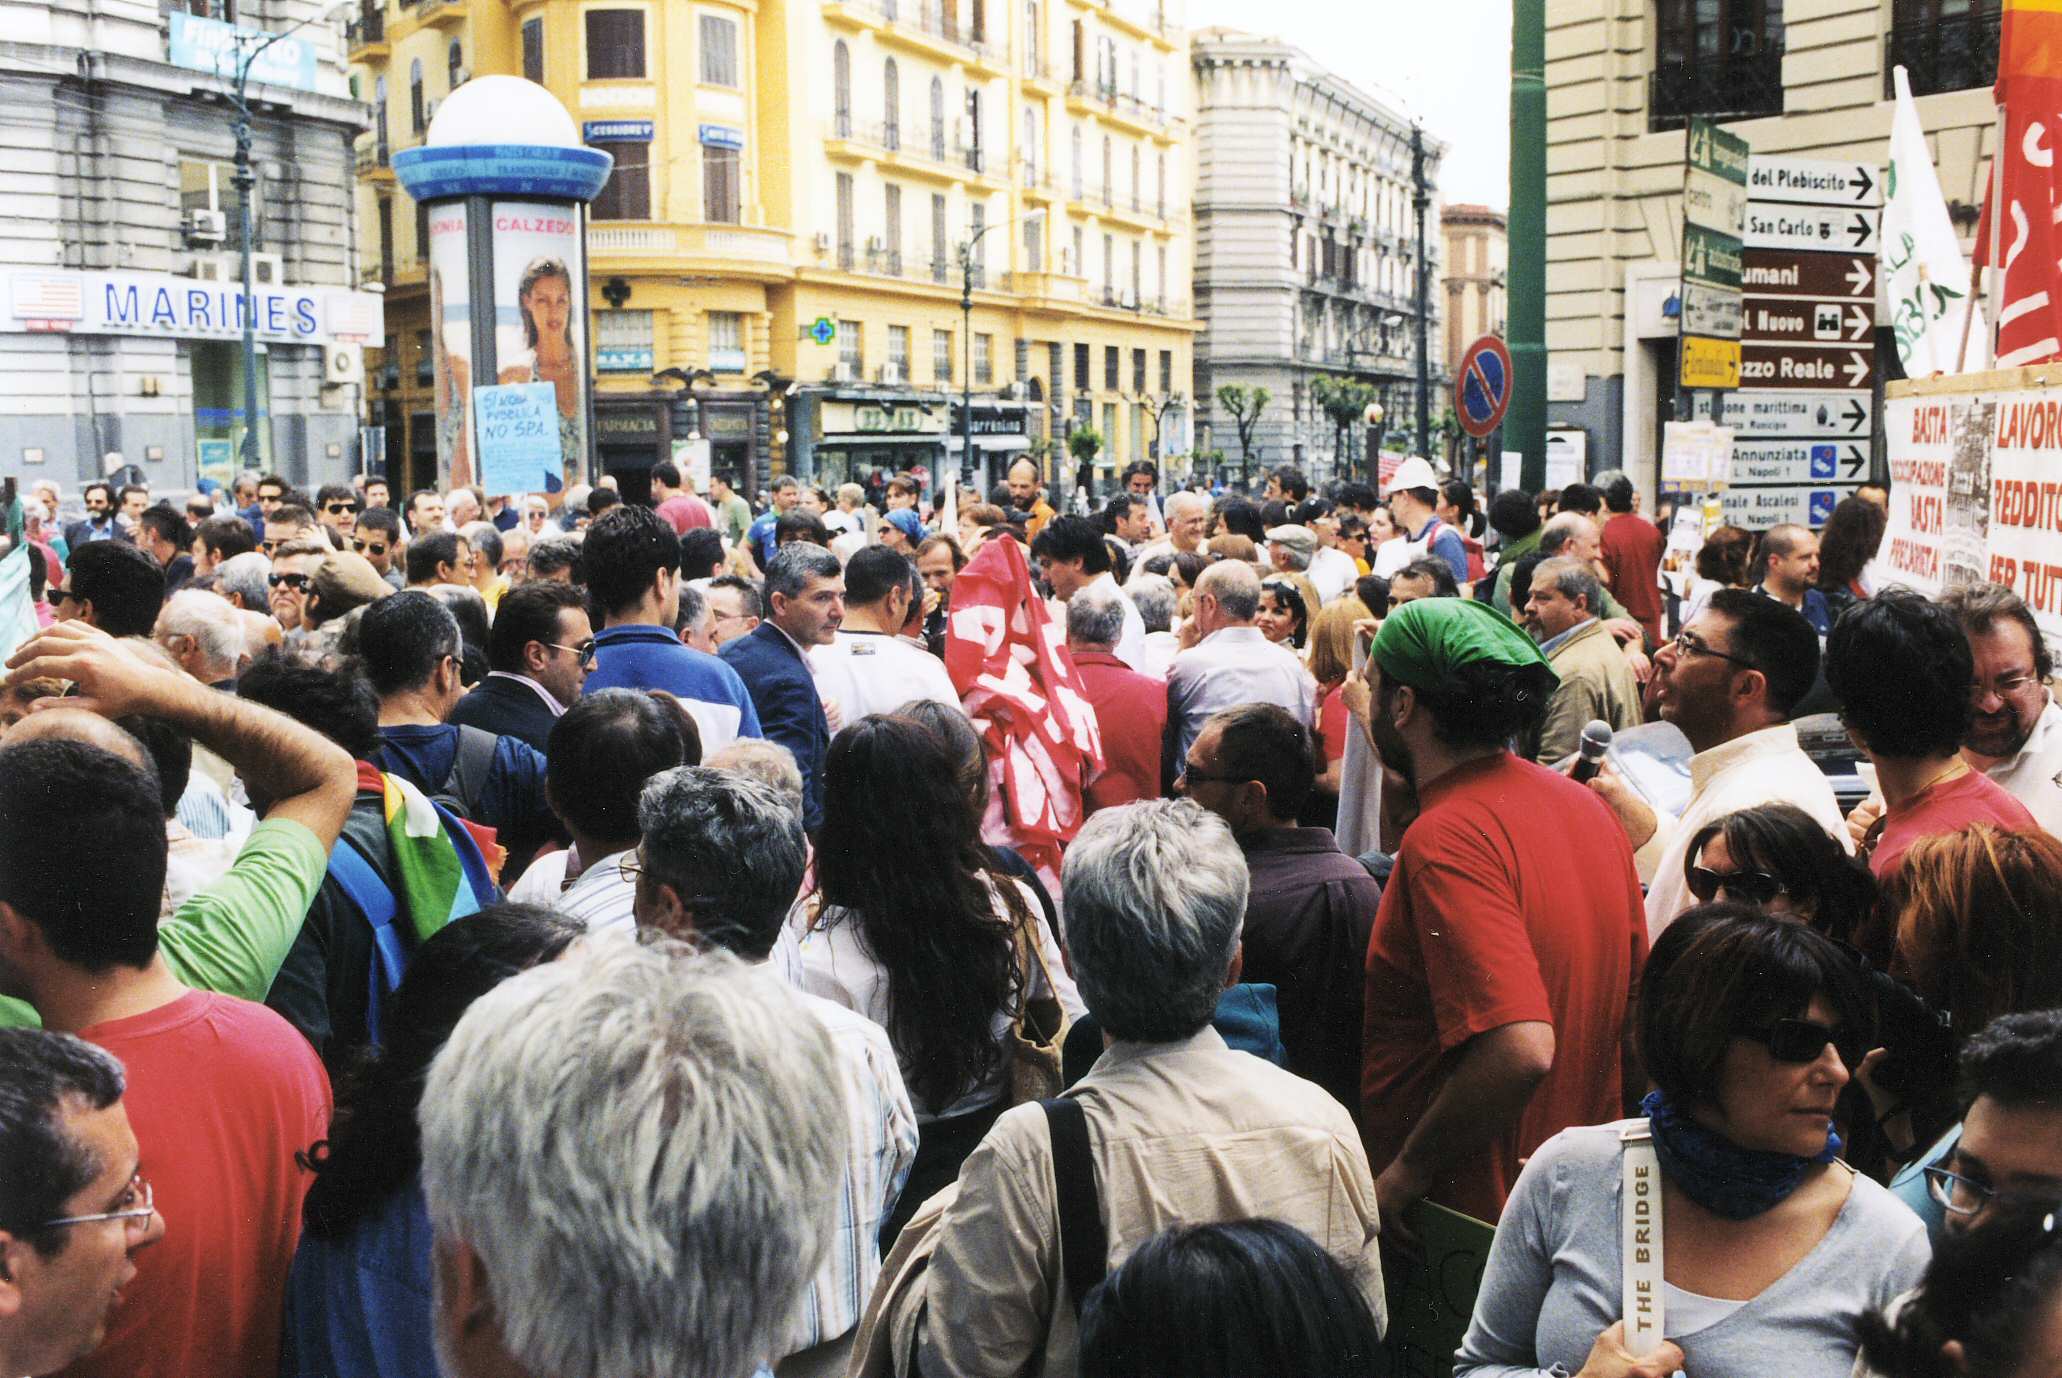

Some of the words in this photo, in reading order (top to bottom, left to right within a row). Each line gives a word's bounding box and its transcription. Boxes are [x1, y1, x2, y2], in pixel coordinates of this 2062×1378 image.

[1752, 168, 1773, 187] del
[1778, 169, 1846, 191] Plebiscito
[1750, 216, 1774, 234] San
[1778, 218, 1814, 236] Carlo
[105, 283, 318, 335] MARINES
[1758, 309, 1804, 332] Nuovo
[1780, 357, 1835, 380] Reale
[1753, 400, 1807, 414] marittima
[1912, 406, 1947, 445] BASTA
[1732, 447, 1807, 461] Annunziata
[1748, 466, 1780, 479] Napoli
[1756, 493, 1799, 508] Ascalesi
[1747, 513, 1780, 526] Napoli
[1989, 553, 2017, 592] PER
[1634, 1165, 1651, 1264] BRIDGE
[1636, 1279, 1652, 1333] THE
